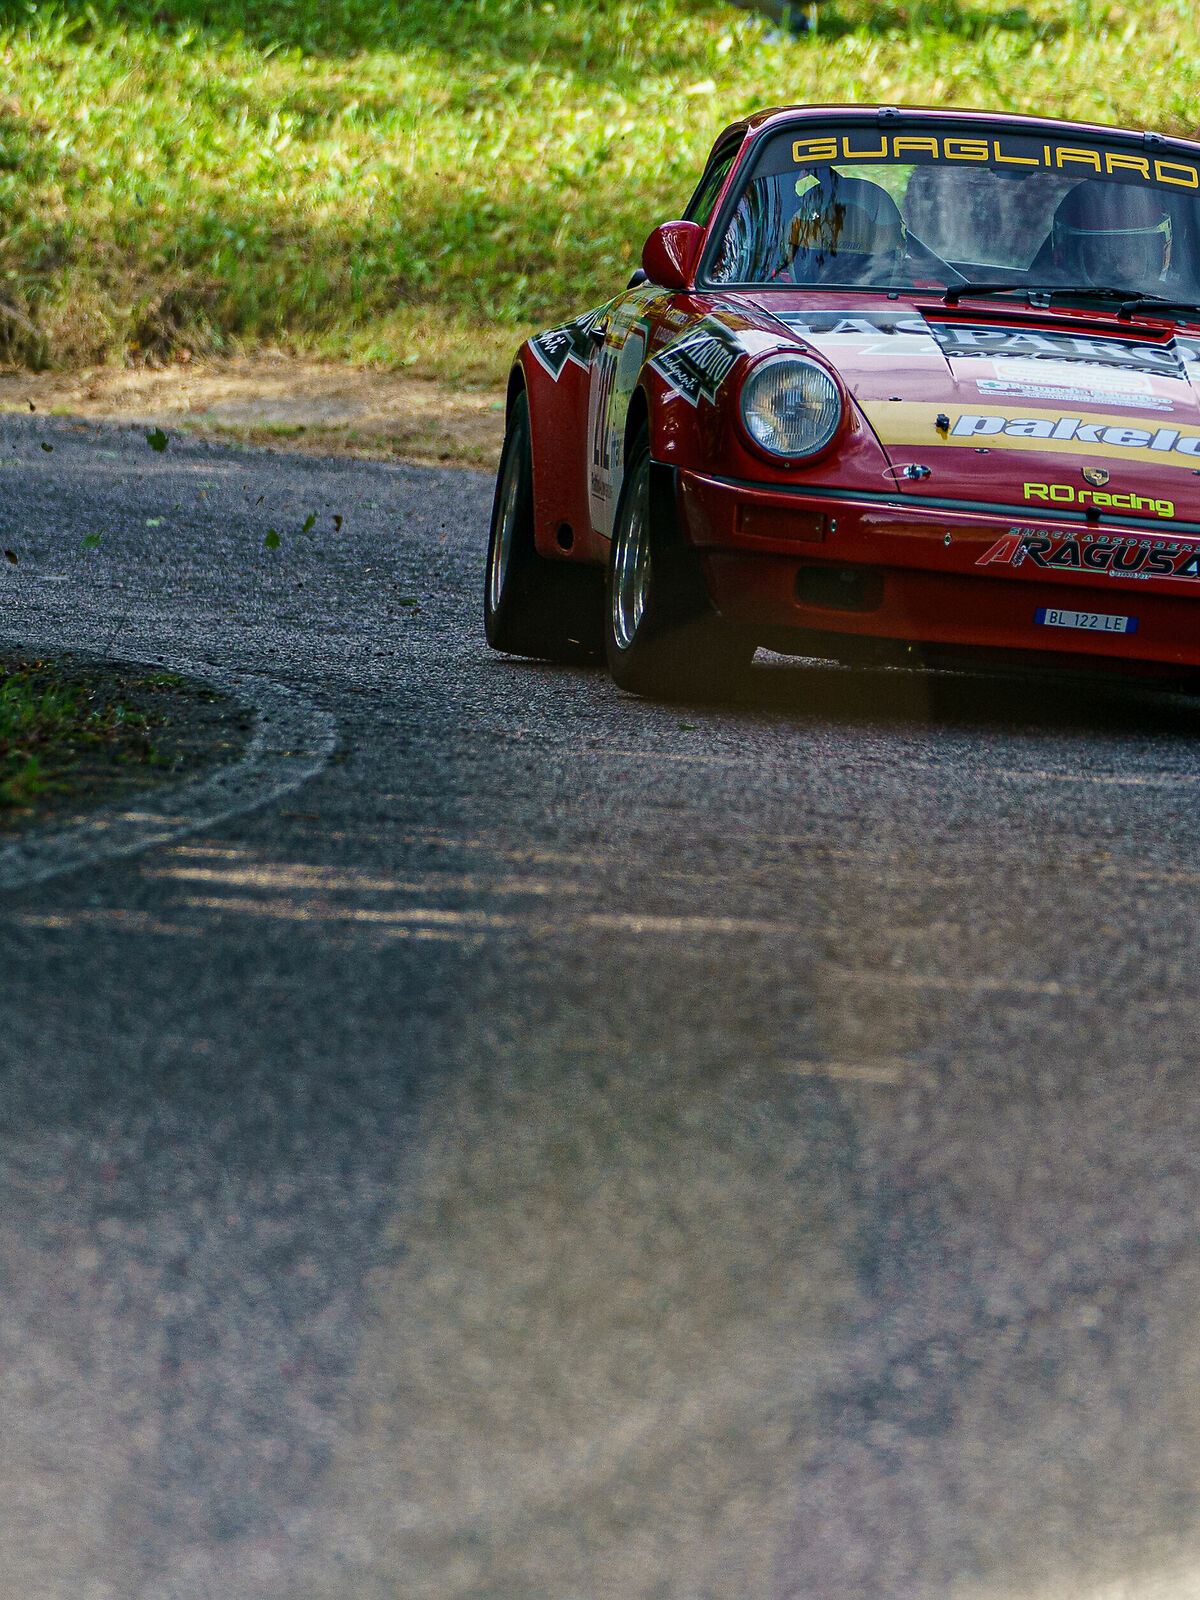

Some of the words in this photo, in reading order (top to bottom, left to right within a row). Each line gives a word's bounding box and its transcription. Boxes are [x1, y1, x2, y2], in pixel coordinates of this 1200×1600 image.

[1023, 482, 1075, 503] RO
[1078, 489, 1175, 518] racing
[1008, 526, 1077, 541] SHOCK
[1049, 611, 1066, 625] BL
[1075, 613, 1099, 628] 122
[1104, 616, 1123, 630] LE
